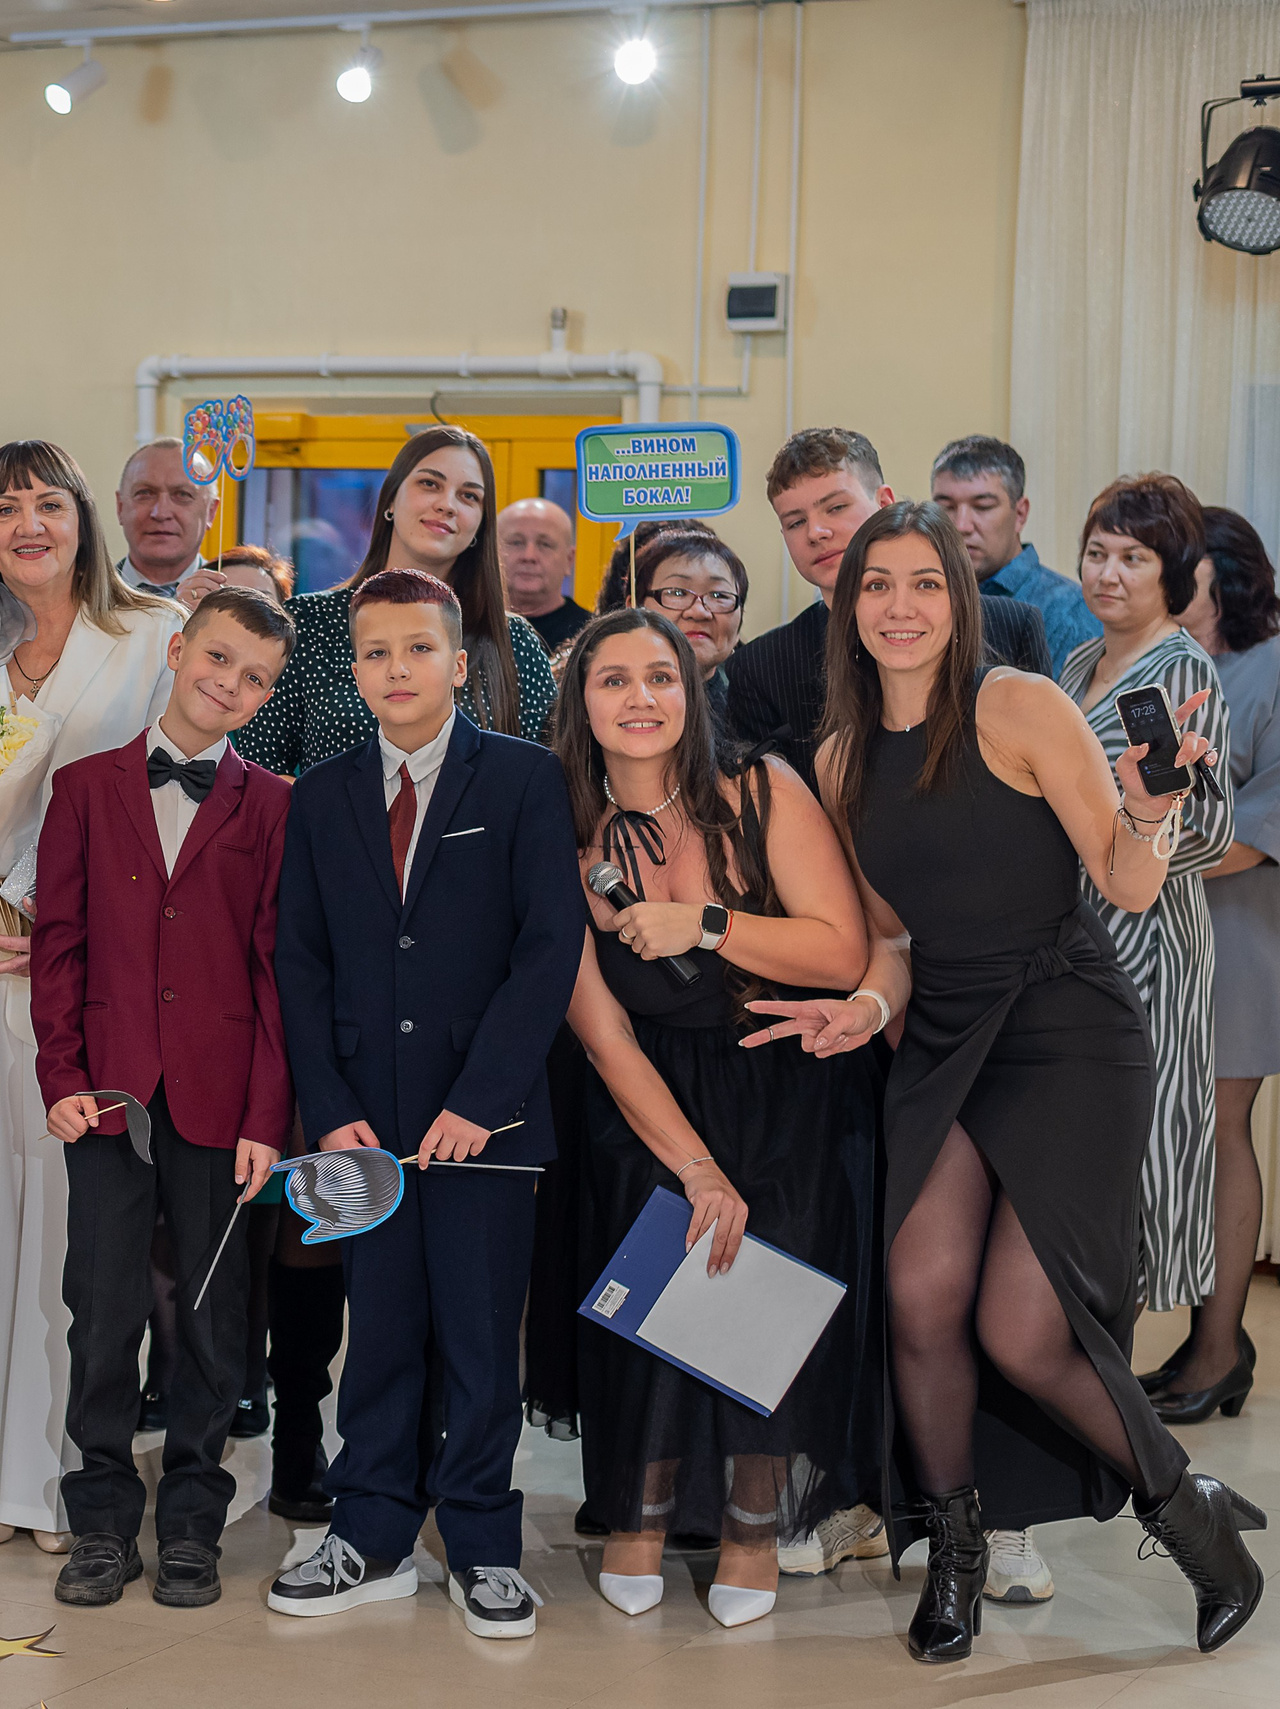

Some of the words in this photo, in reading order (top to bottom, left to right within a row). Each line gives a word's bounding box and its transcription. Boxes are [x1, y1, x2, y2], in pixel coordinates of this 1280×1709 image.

[615, 437, 697, 455] ...ВИНОМ
[588, 456, 727, 481] НАПОЛНЕННЫЙ
[623, 487, 691, 505] БОКАЛ!
[1131, 703, 1156, 718] 17:28
